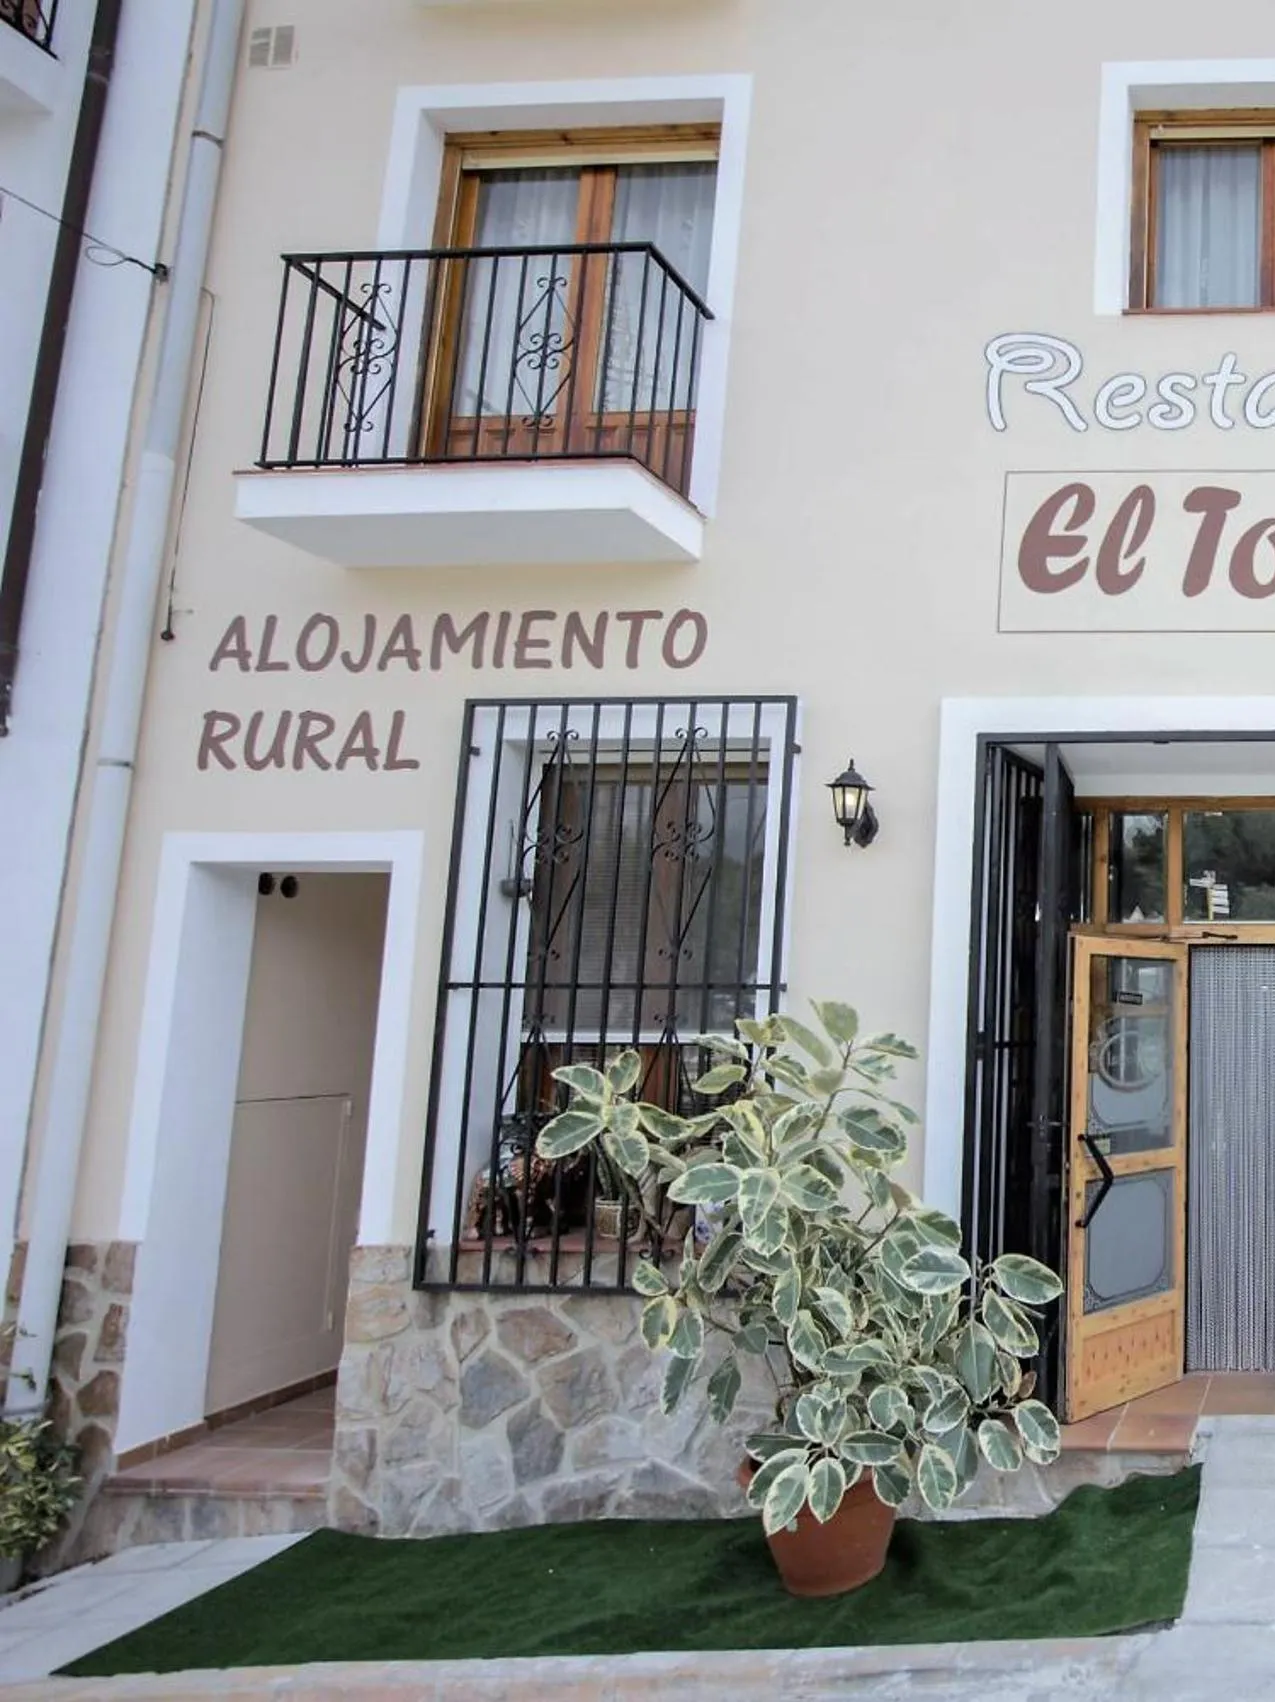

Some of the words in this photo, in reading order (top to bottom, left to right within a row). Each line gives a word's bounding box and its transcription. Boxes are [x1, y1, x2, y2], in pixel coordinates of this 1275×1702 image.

[1016, 482, 1156, 596] El
[208, 608, 709, 673] ALOJAMIENTO
[196, 709, 420, 771] RURAL
